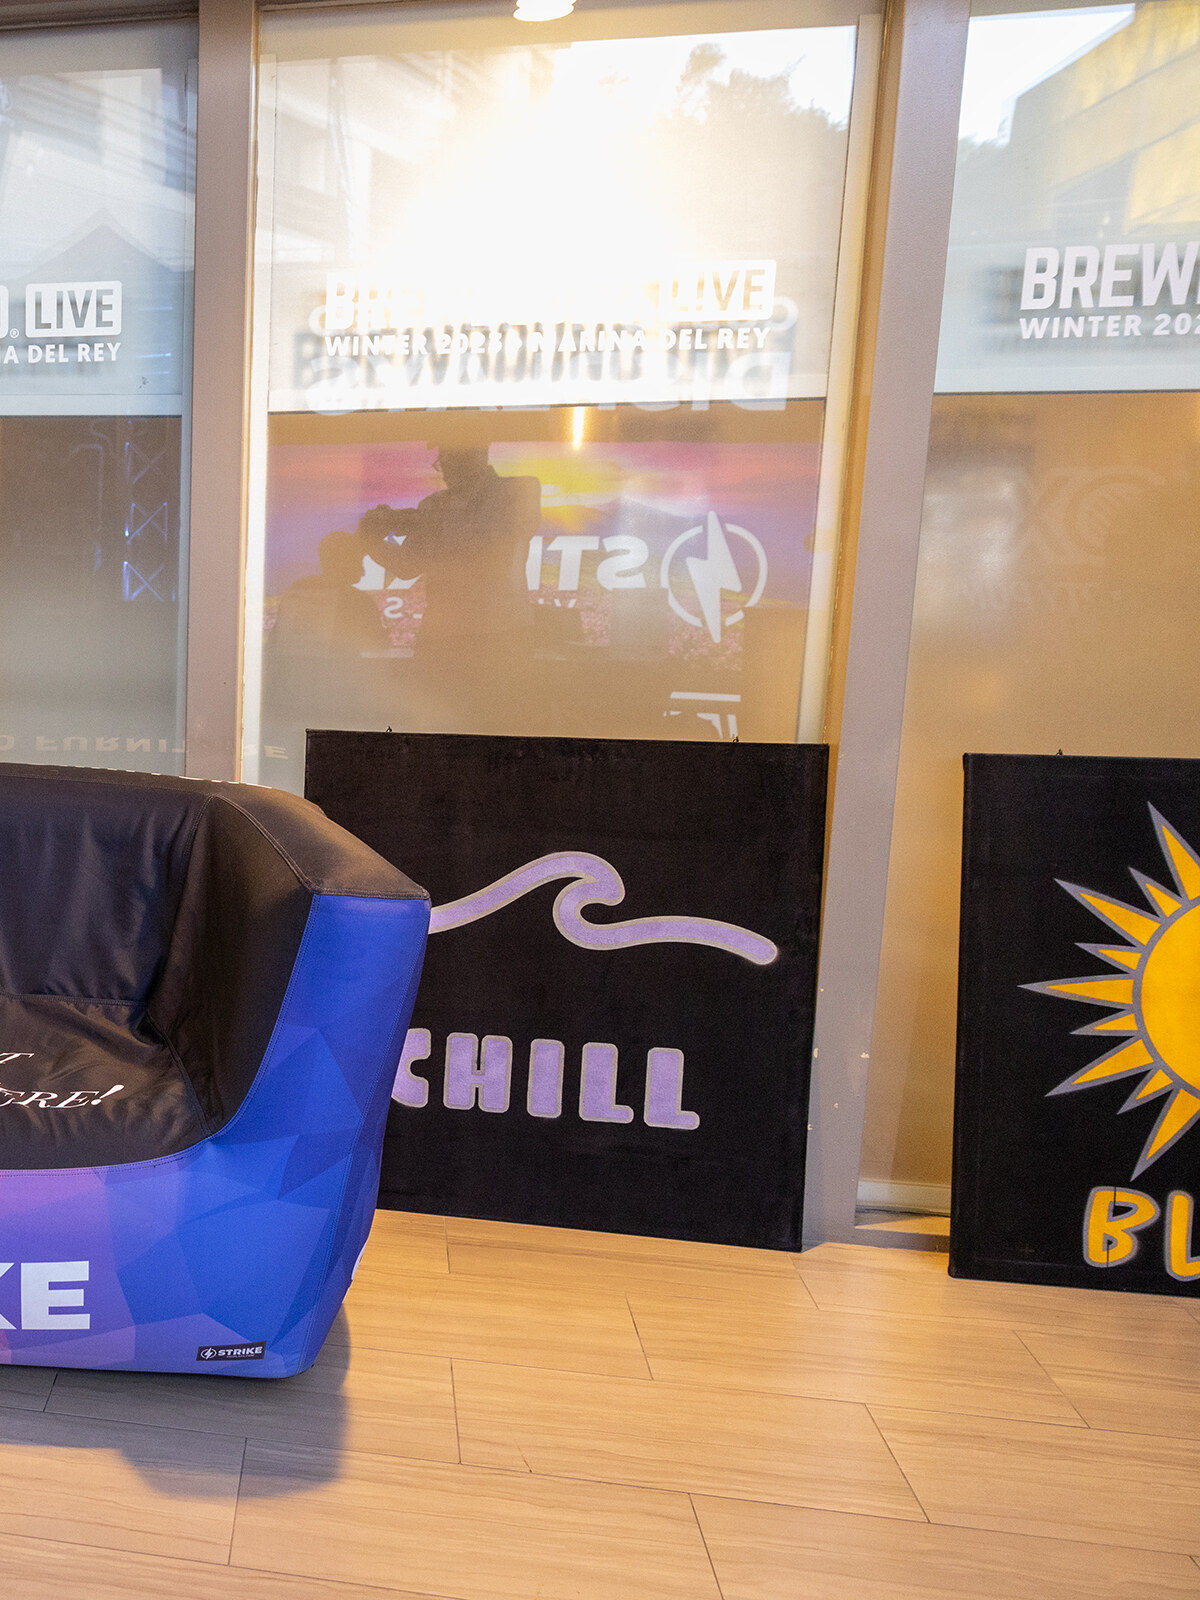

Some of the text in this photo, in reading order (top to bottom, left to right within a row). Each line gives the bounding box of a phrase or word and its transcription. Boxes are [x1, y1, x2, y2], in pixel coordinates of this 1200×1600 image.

[669, 268, 767, 312] LIVE
[1020, 241, 1200, 310] BREW
[31, 286, 118, 331] LIVE
[1019, 315, 1142, 339] WINTER
[28, 344, 67, 364] DEL
[78, 342, 122, 363] REY
[325, 335, 428, 357] WINTER
[662, 328, 707, 350] DEL
[717, 327, 772, 349] REY
[391, 1027, 700, 1130] CHILL
[217, 1346, 263, 1357] STRIKE
